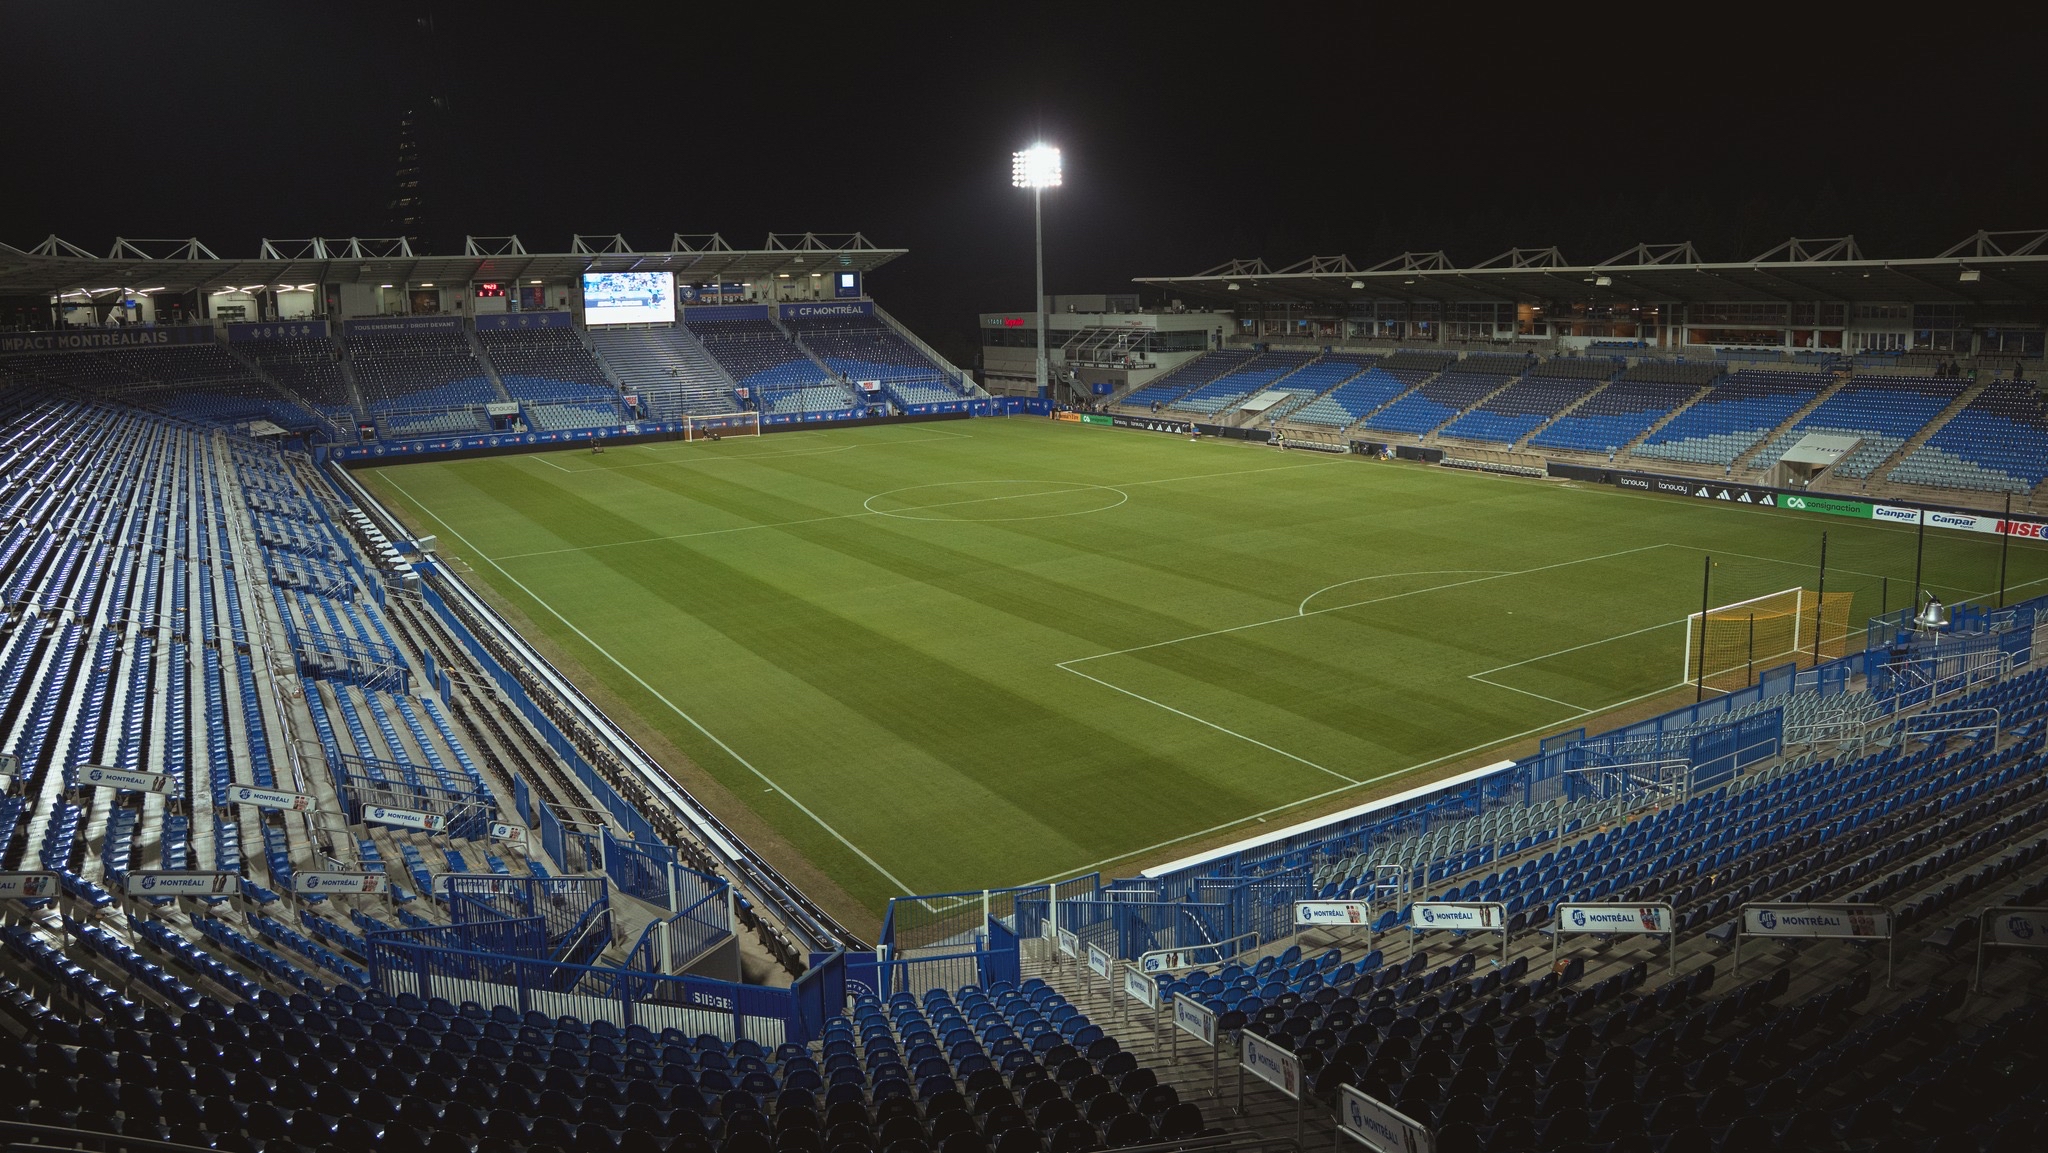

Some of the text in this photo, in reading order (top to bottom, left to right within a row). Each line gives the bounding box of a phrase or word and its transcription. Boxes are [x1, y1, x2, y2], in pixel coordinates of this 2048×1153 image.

[800, 304, 864, 316] CF MONTRÉAL
[1, 331, 168, 351] IMPACT MONTRÉALAIS
[1806, 500, 1861, 513] consignaction
[1875, 508, 1917, 520] Canpar
[1931, 514, 1977, 527] Canpar
[105, 774, 146, 785] MONTRÉAL!
[253, 793, 290, 804] MONTRÉAL!
[387, 812, 421, 822] MONTRÉAL!
[159, 877, 204, 887] MONTRÉAL!
[321, 878, 358, 886] MONTRÉAL!
[1313, 909, 1344, 917] MONTRÉAL!
[1436, 911, 1473, 920] MONTRÉAL!
[1589, 912, 1634, 922] MONTRÉAL!
[1782, 915, 1840, 926] MONTRÉAL!
